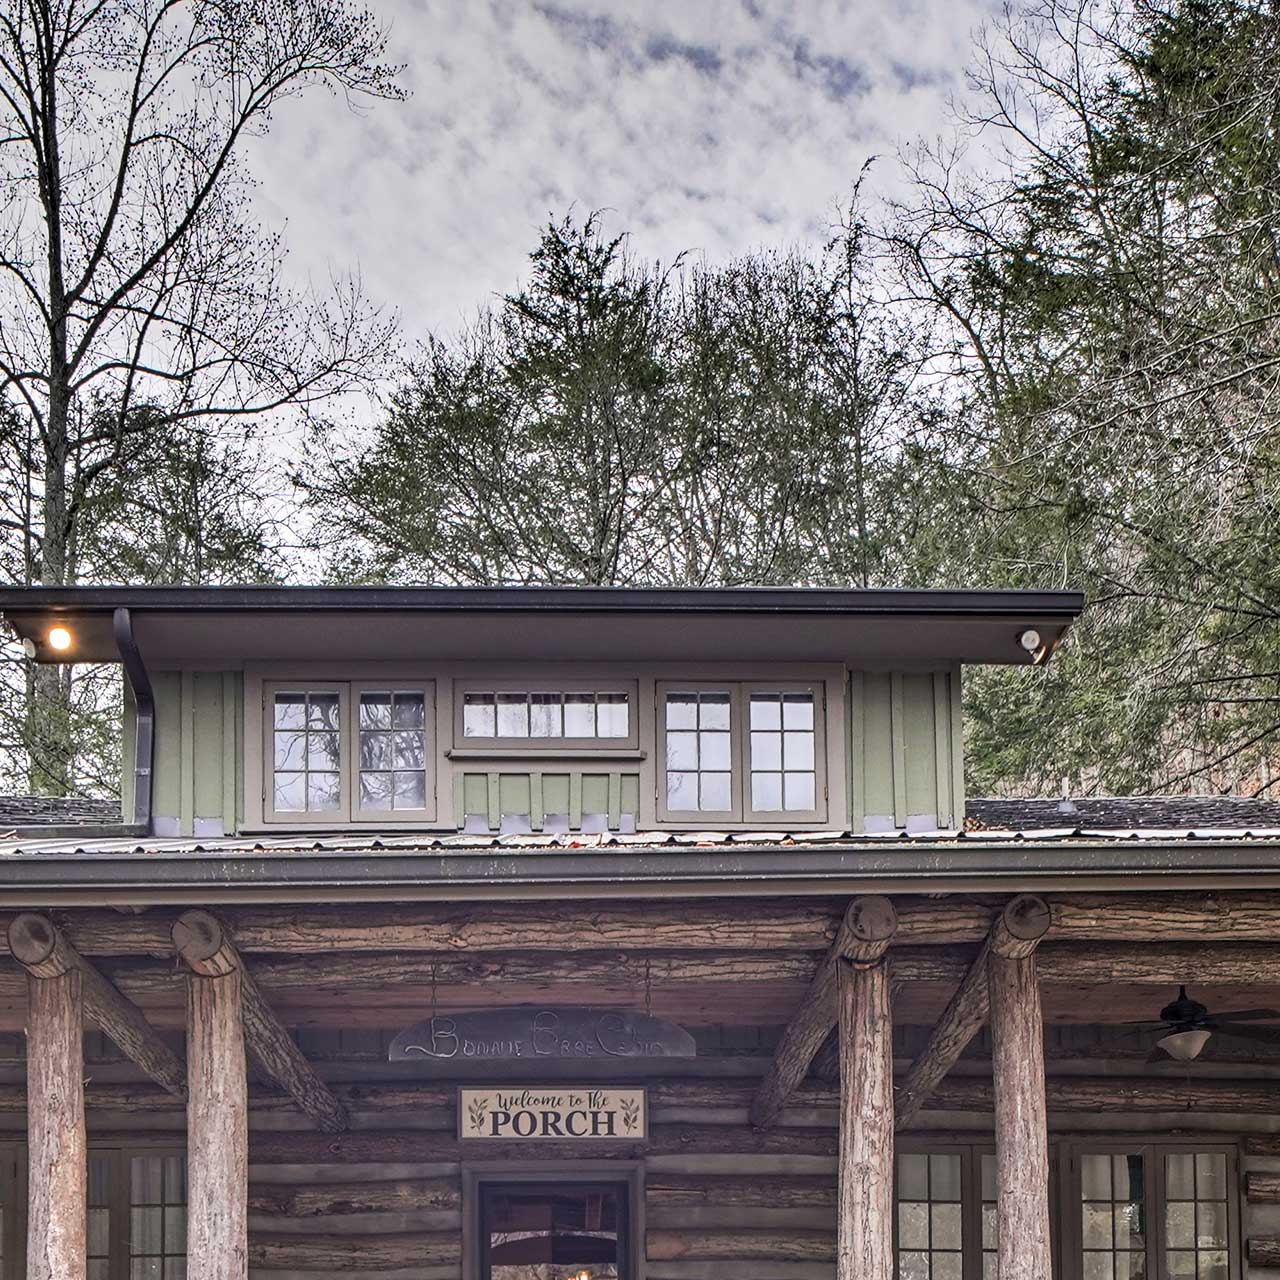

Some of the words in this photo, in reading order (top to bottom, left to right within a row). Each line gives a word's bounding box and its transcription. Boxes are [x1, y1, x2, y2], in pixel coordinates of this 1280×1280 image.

[497, 1091, 564, 1110] Welcome
[569, 1094, 584, 1107] to
[588, 1090, 610, 1110] The
[489, 1110, 617, 1137] PORCH
